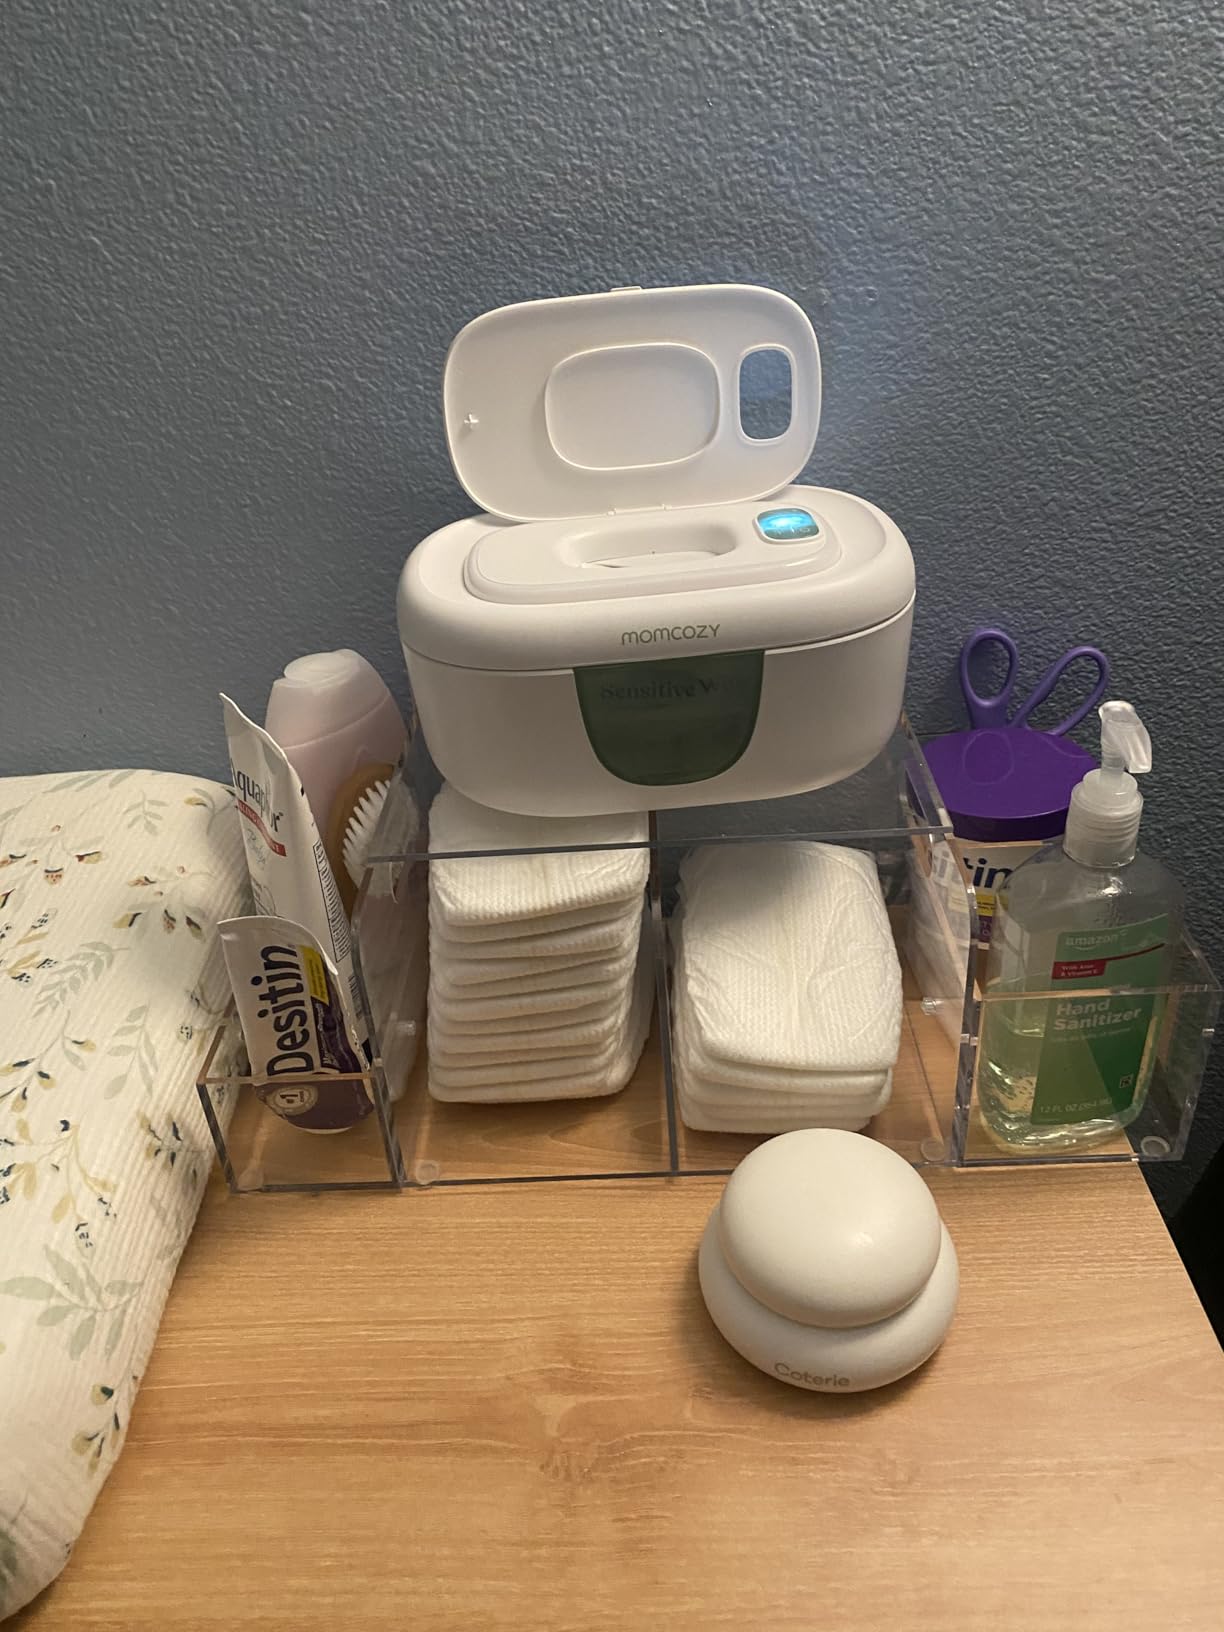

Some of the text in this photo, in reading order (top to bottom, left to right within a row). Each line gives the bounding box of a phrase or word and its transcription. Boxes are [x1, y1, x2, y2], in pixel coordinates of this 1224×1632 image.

[602, 680, 696, 699] Sensitive
[1065, 933, 1119, 946] amazon
[251, 945, 315, 1076] Desitin
[1056, 999, 1111, 1016] Hand
[1053, 1008, 1142, 1031] Sanitizer
[774, 1362, 850, 1387] Coterie
